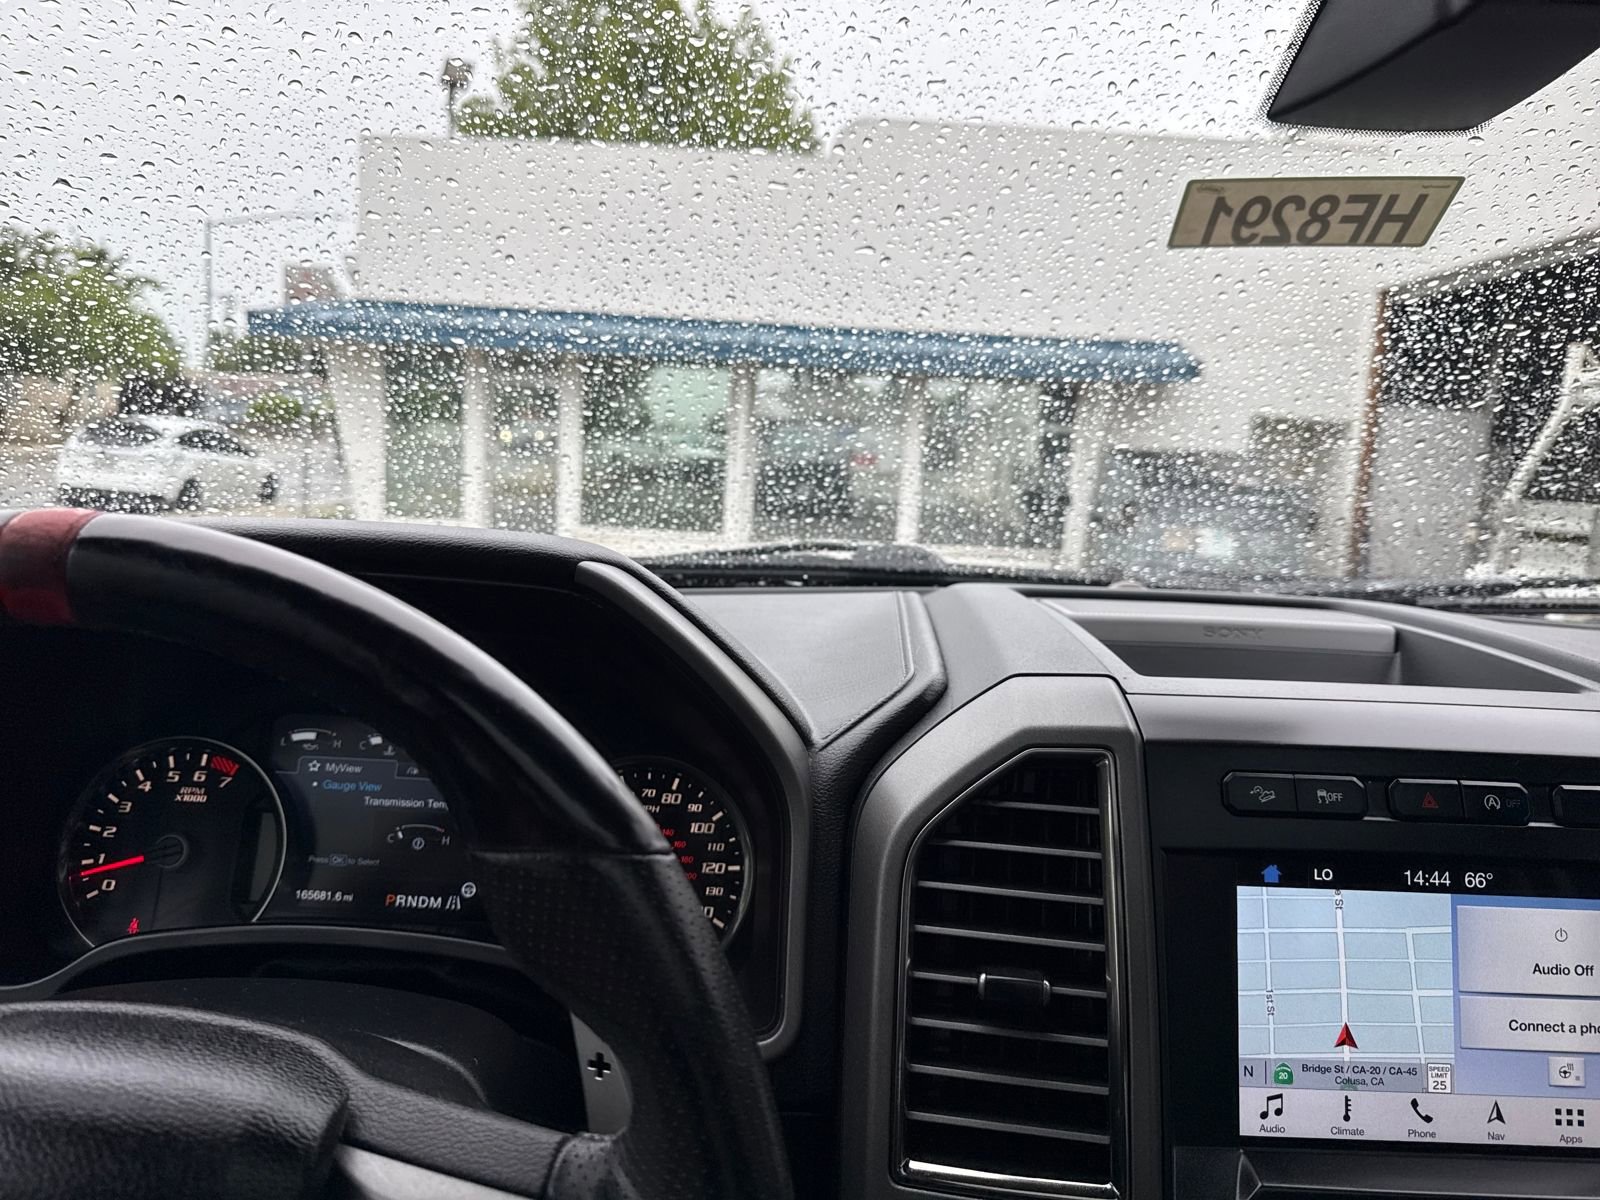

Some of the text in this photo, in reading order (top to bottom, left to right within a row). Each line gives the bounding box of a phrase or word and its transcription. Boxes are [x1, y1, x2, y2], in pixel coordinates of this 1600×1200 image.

[325, 763, 363, 775] MyView
[166, 771, 181, 783] 5
[192, 771, 207, 782] 6
[137, 781, 152, 792] 4
[218, 777, 232, 788] 7
[323, 780, 383, 792] Gauge View
[180, 786, 205, 795] RPM
[642, 788, 657, 798] 70
[364, 796, 425, 808] Transmission
[661, 793, 682, 805] 80
[1327, 792, 1343, 802] OFF
[118, 801, 132, 813] 3
[645, 804, 660, 813] PH
[687, 803, 703, 813] 90
[102, 826, 117, 838] 2
[690, 822, 715, 834] 100
[707, 842, 725, 852] 110
[98, 853, 106, 865] 1
[308, 855, 329, 864] Press
[701, 862, 725, 875] 120
[686, 872, 697, 880] 00
[1313, 868, 1333, 881] LO
[1404, 870, 1451, 887] 14:44
[101, 879, 116, 891] 0
[1465, 872, 1493, 889] 66°
[295, 889, 342, 902] 165681.6
[705, 887, 724, 897] 130
[1335, 899, 1343, 909] St
[1533, 963, 1594, 977] Audio Off
[1266, 1005, 1275, 1016] St
[1508, 1019, 1565, 1033] Connect
[1568, 1024, 1577, 1034] a
[1243, 1065, 1254, 1077] N
[1278, 1071, 1288, 1080] 20
[1301, 1063, 1331, 1076] Bridge
[1334, 1064, 1344, 1074] St
[1351, 1066, 1381, 1076] CA-20
[1389, 1067, 1418, 1077] CA-45
[1430, 1072, 1448, 1080] LIMIT
[1370, 1077, 1385, 1087] CA
[1432, 1080, 1447, 1091] 25
[1259, 1123, 1285, 1134] Audio
[1330, 1126, 1365, 1137] Climate
[1407, 1129, 1436, 1140] Phone
[1487, 1132, 1505, 1142] Nav
[1559, 1134, 1583, 1146] Apps
